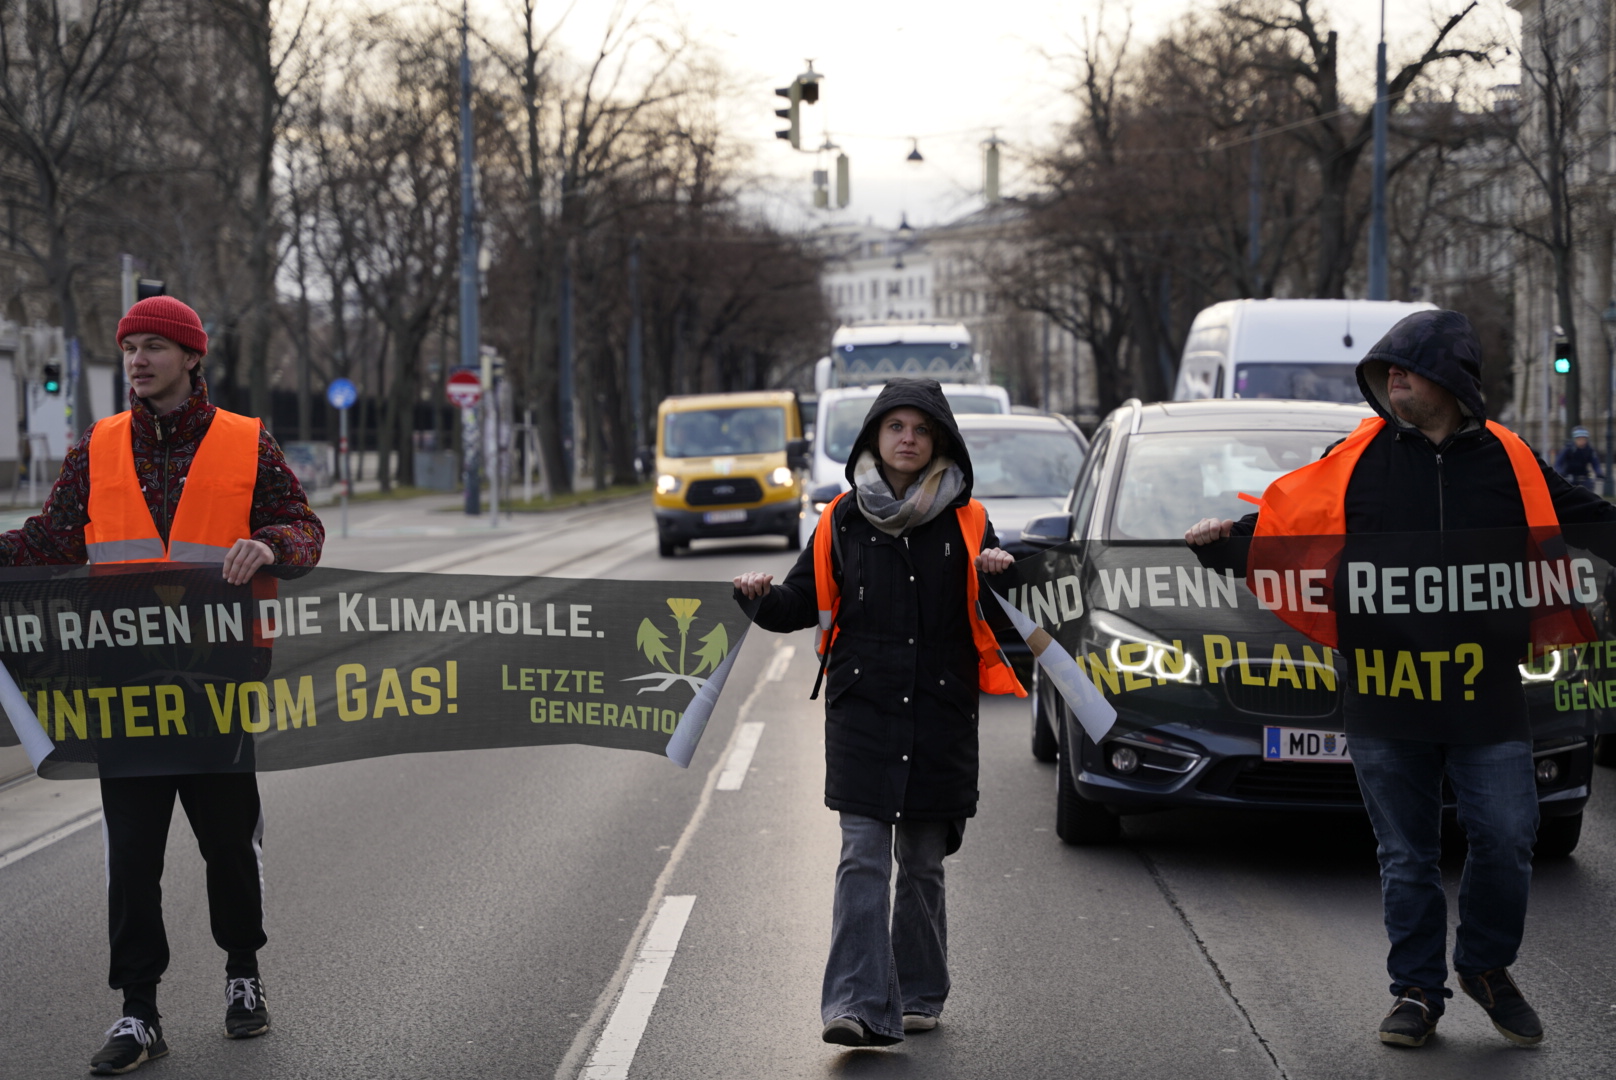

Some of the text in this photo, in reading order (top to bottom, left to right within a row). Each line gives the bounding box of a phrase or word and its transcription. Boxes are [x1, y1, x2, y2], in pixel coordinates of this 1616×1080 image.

[1099, 566, 1238, 611] WENN
[1253, 569, 1328, 613] DIE
[1348, 558, 1598, 614] REGIERUNG
[58, 605, 191, 651] RASEN
[204, 602, 243, 643] IN
[259, 596, 321, 639] DIE
[339, 592, 604, 638] KLIMAHÖLLE.
[502, 664, 604, 694] LETZTE
[1203, 634, 1336, 692] PLAN
[1355, 643, 1484, 701] HAT?
[1527, 640, 1616, 673] LETZTE
[23, 685, 187, 741] NTER
[205, 675, 317, 734] VOM
[336, 660, 457, 722] GAS!
[530, 698, 683, 735] GENERATIO
[1290, 733, 1320, 755] MD
